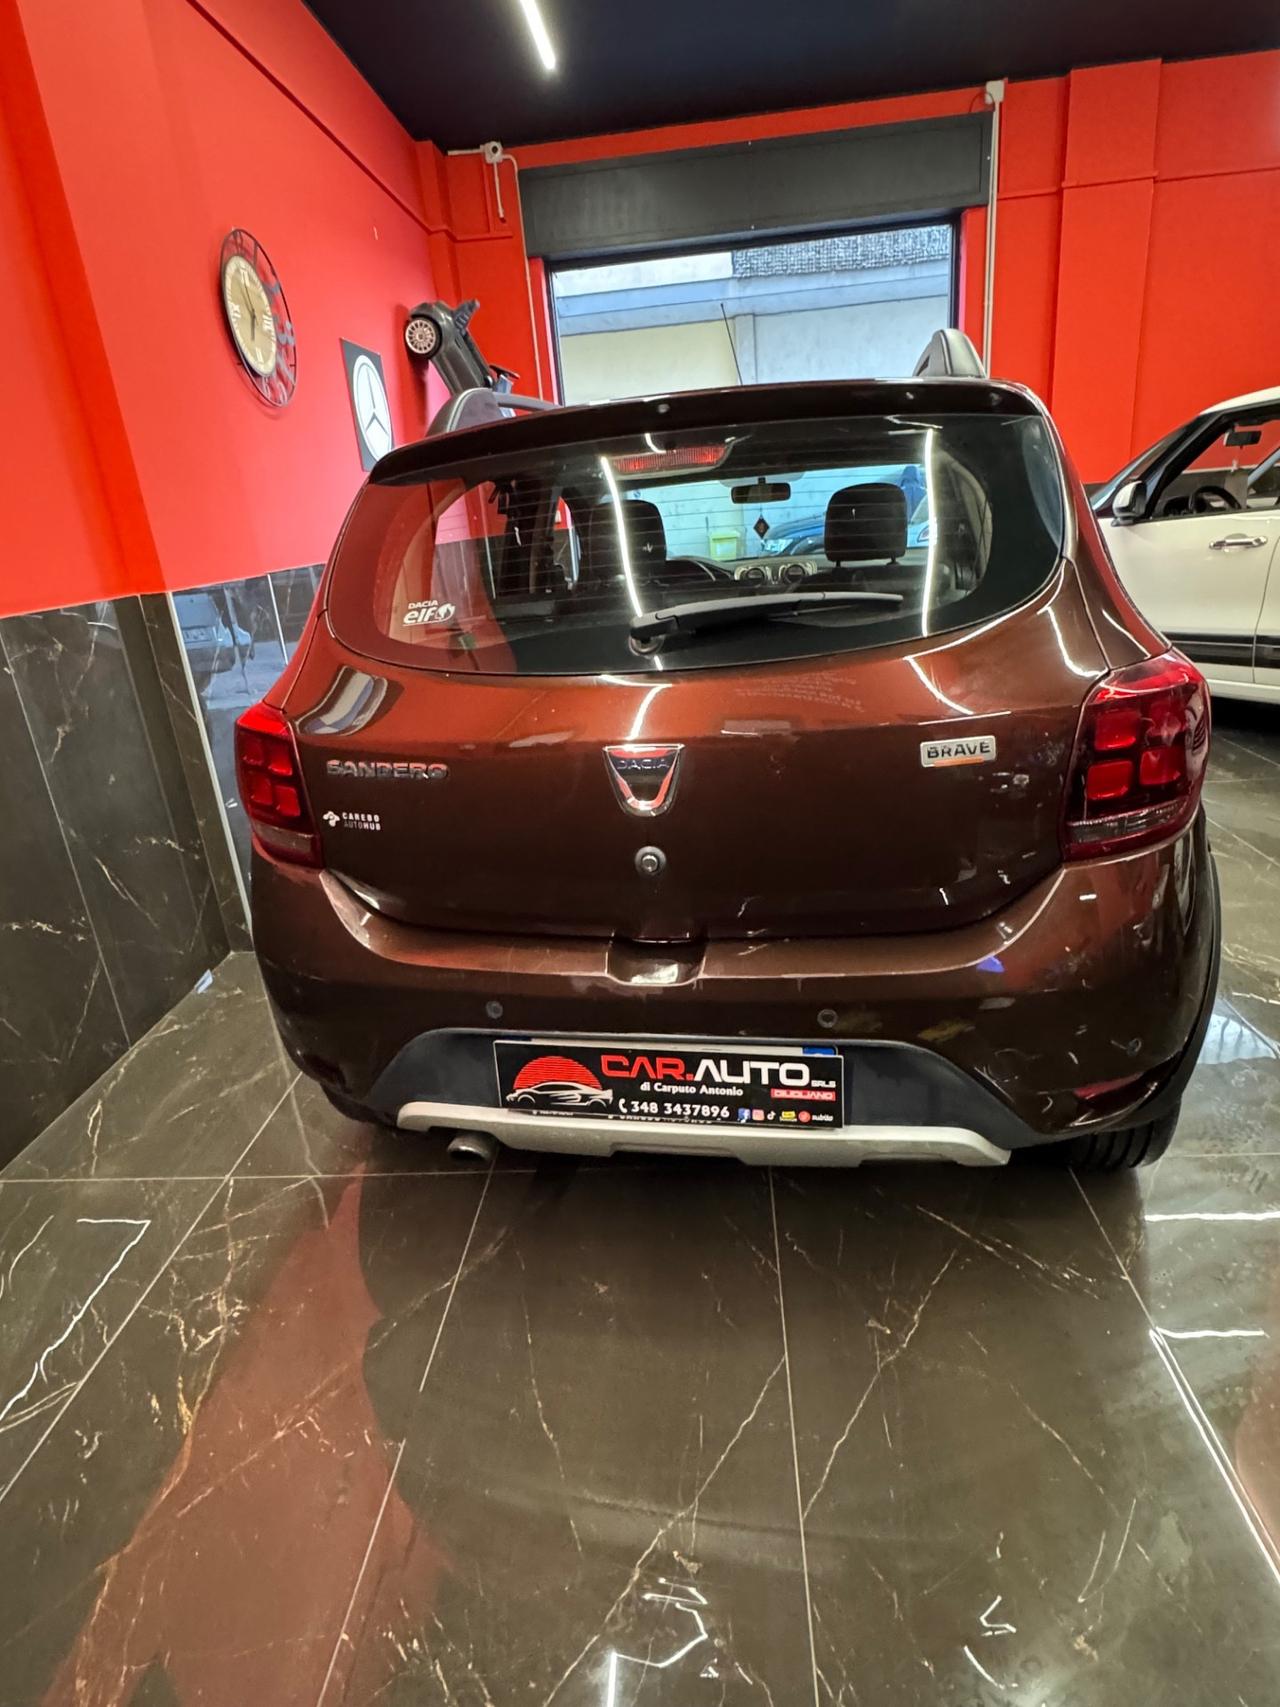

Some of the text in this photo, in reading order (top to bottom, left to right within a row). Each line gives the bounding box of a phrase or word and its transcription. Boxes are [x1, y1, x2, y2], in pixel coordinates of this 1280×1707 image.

[408, 600, 439, 610] DACIA
[403, 607, 437, 624] elf
[926, 741, 991, 759] BRAVE
[326, 759, 449, 780] SANDERO
[344, 820, 381, 831] AUTOHUB
[640, 1081, 744, 1097] di Carputo Antonio
[630, 1100, 730, 1118] 348 3437896
